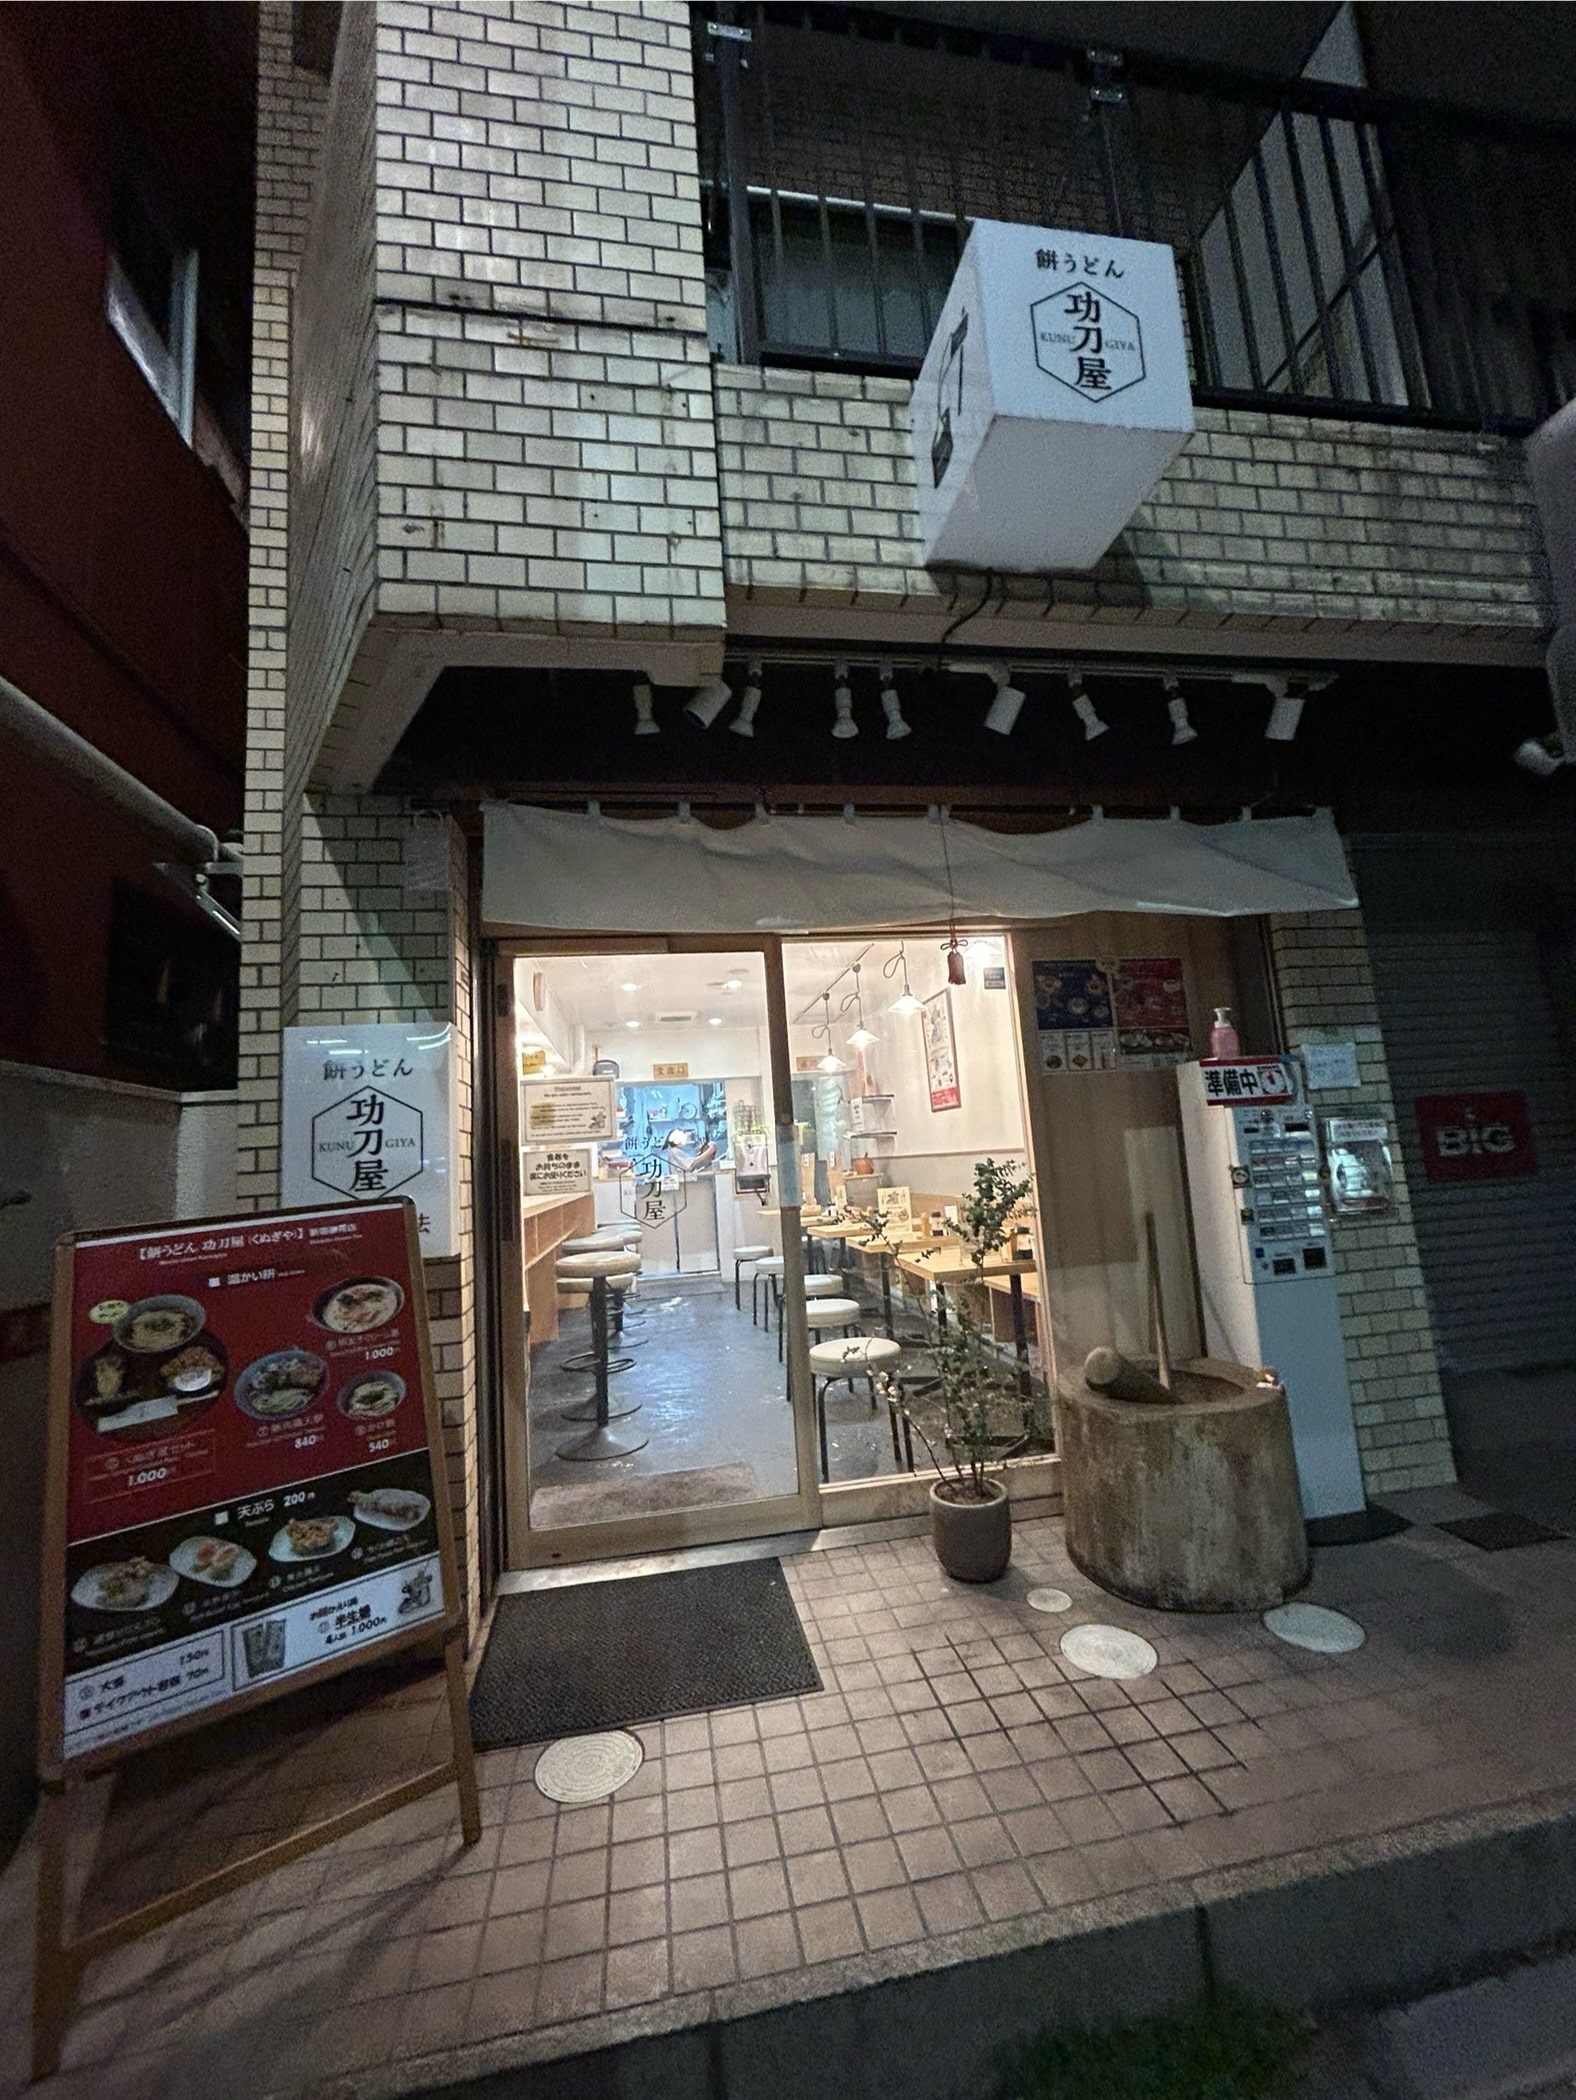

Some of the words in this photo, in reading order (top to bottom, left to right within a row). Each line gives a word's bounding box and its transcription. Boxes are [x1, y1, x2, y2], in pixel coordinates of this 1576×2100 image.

[1036, 248, 1124, 279] 餅うどん
[1040, 332, 1075, 345] KUNU
[1105, 340, 1136, 352] GIYA
[1064, 291, 1112, 391] 功刀屋
[1205, 1069, 1258, 1097] 準備中
[319, 1141, 355, 1153] KUNU
[385, 1139, 416, 1149] GIYA
[347, 1094, 389, 1192] 功刀屋
[635, 1159, 666, 1221] 功刀屋
